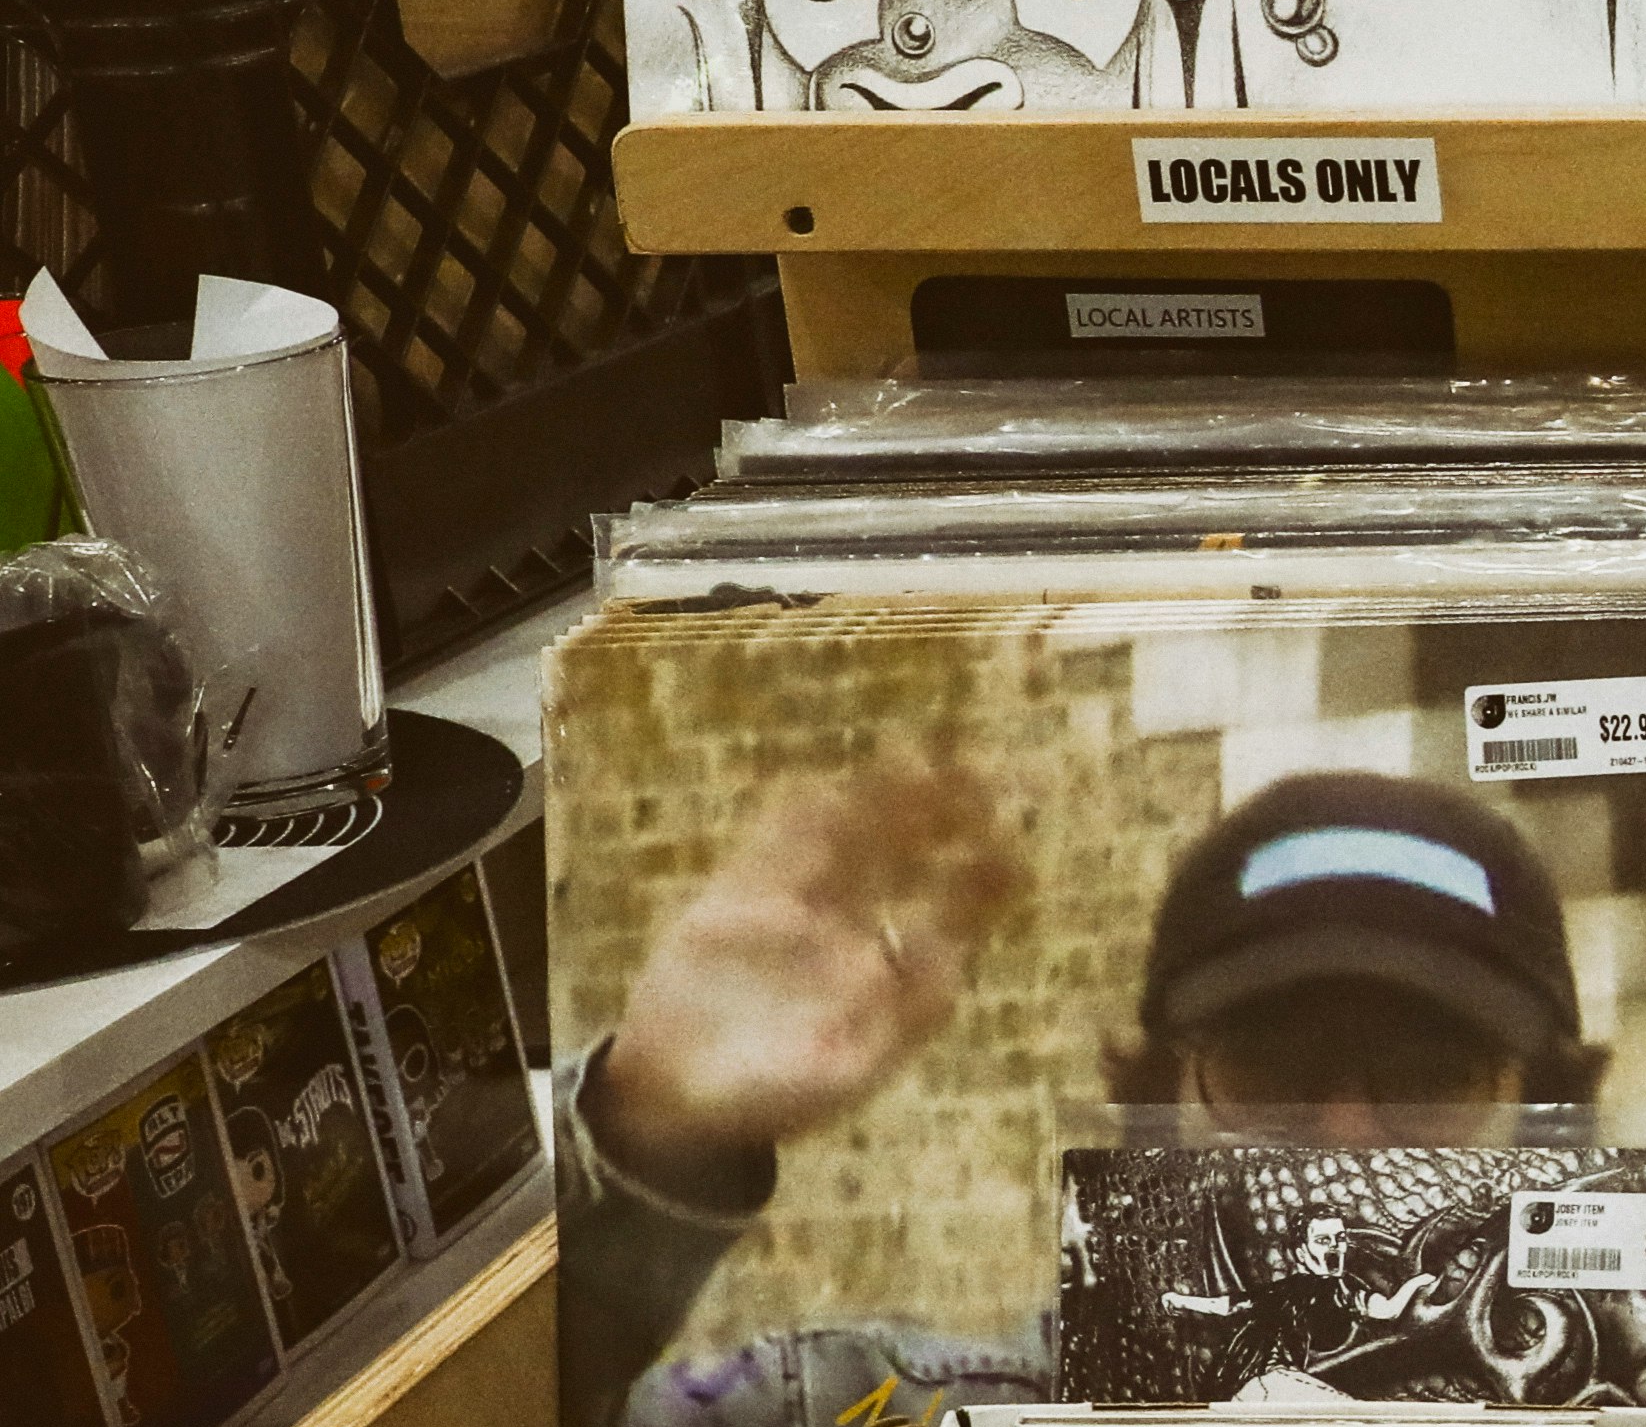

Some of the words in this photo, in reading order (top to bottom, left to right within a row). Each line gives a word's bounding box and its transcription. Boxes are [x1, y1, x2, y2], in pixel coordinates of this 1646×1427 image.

[1147, 157, 1309, 204] LOCALS
[1315, 157, 1421, 204] ONLY
[1075, 306, 1153, 332] LOCAL
[1159, 305, 1255, 331] ARTISTS
